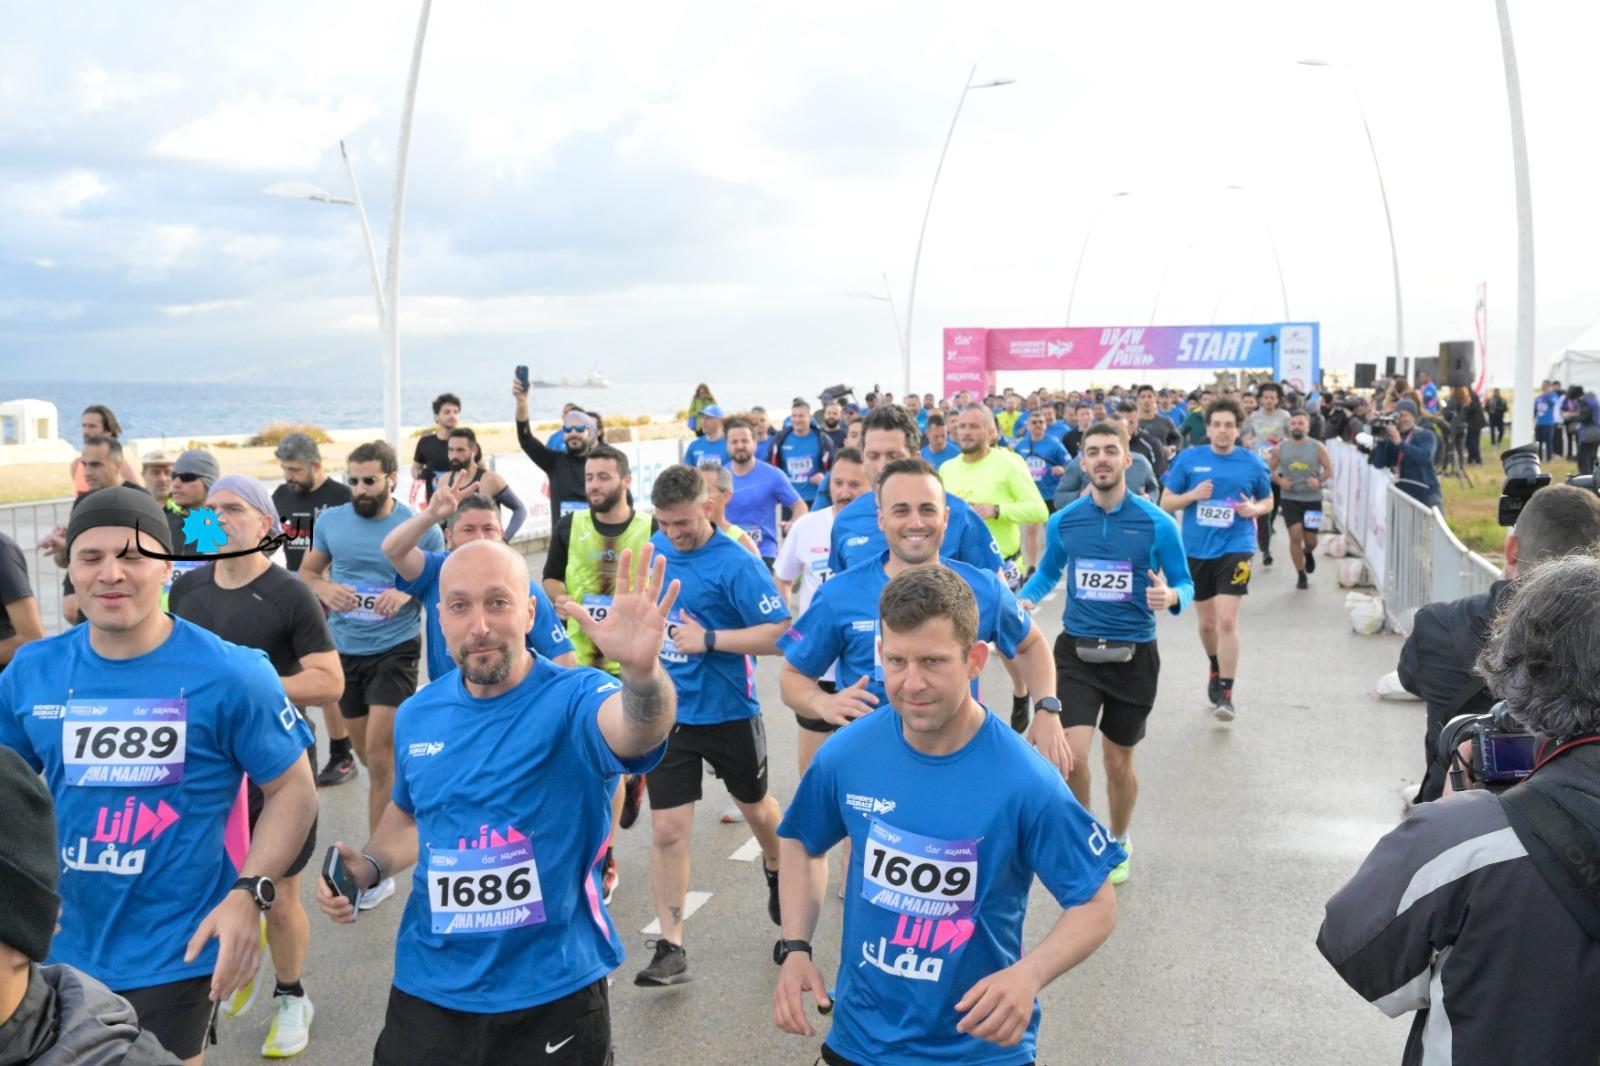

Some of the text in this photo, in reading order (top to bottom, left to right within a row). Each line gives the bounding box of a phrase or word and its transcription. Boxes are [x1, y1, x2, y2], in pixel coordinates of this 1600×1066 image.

[1176, 331, 1259, 362] START
[1200, 507, 1231, 520] 1826
[1081, 573, 1129, 589] 1825
[74, 726, 179, 760] 1689
[76, 765, 109, 786] ANA
[481, 853, 496, 864] dar
[925, 844, 941, 855] dar
[870, 848, 971, 897] 1609
[437, 867, 531, 908] 1686
[870, 889, 901, 908] ANA
[444, 912, 474, 934] ANA
